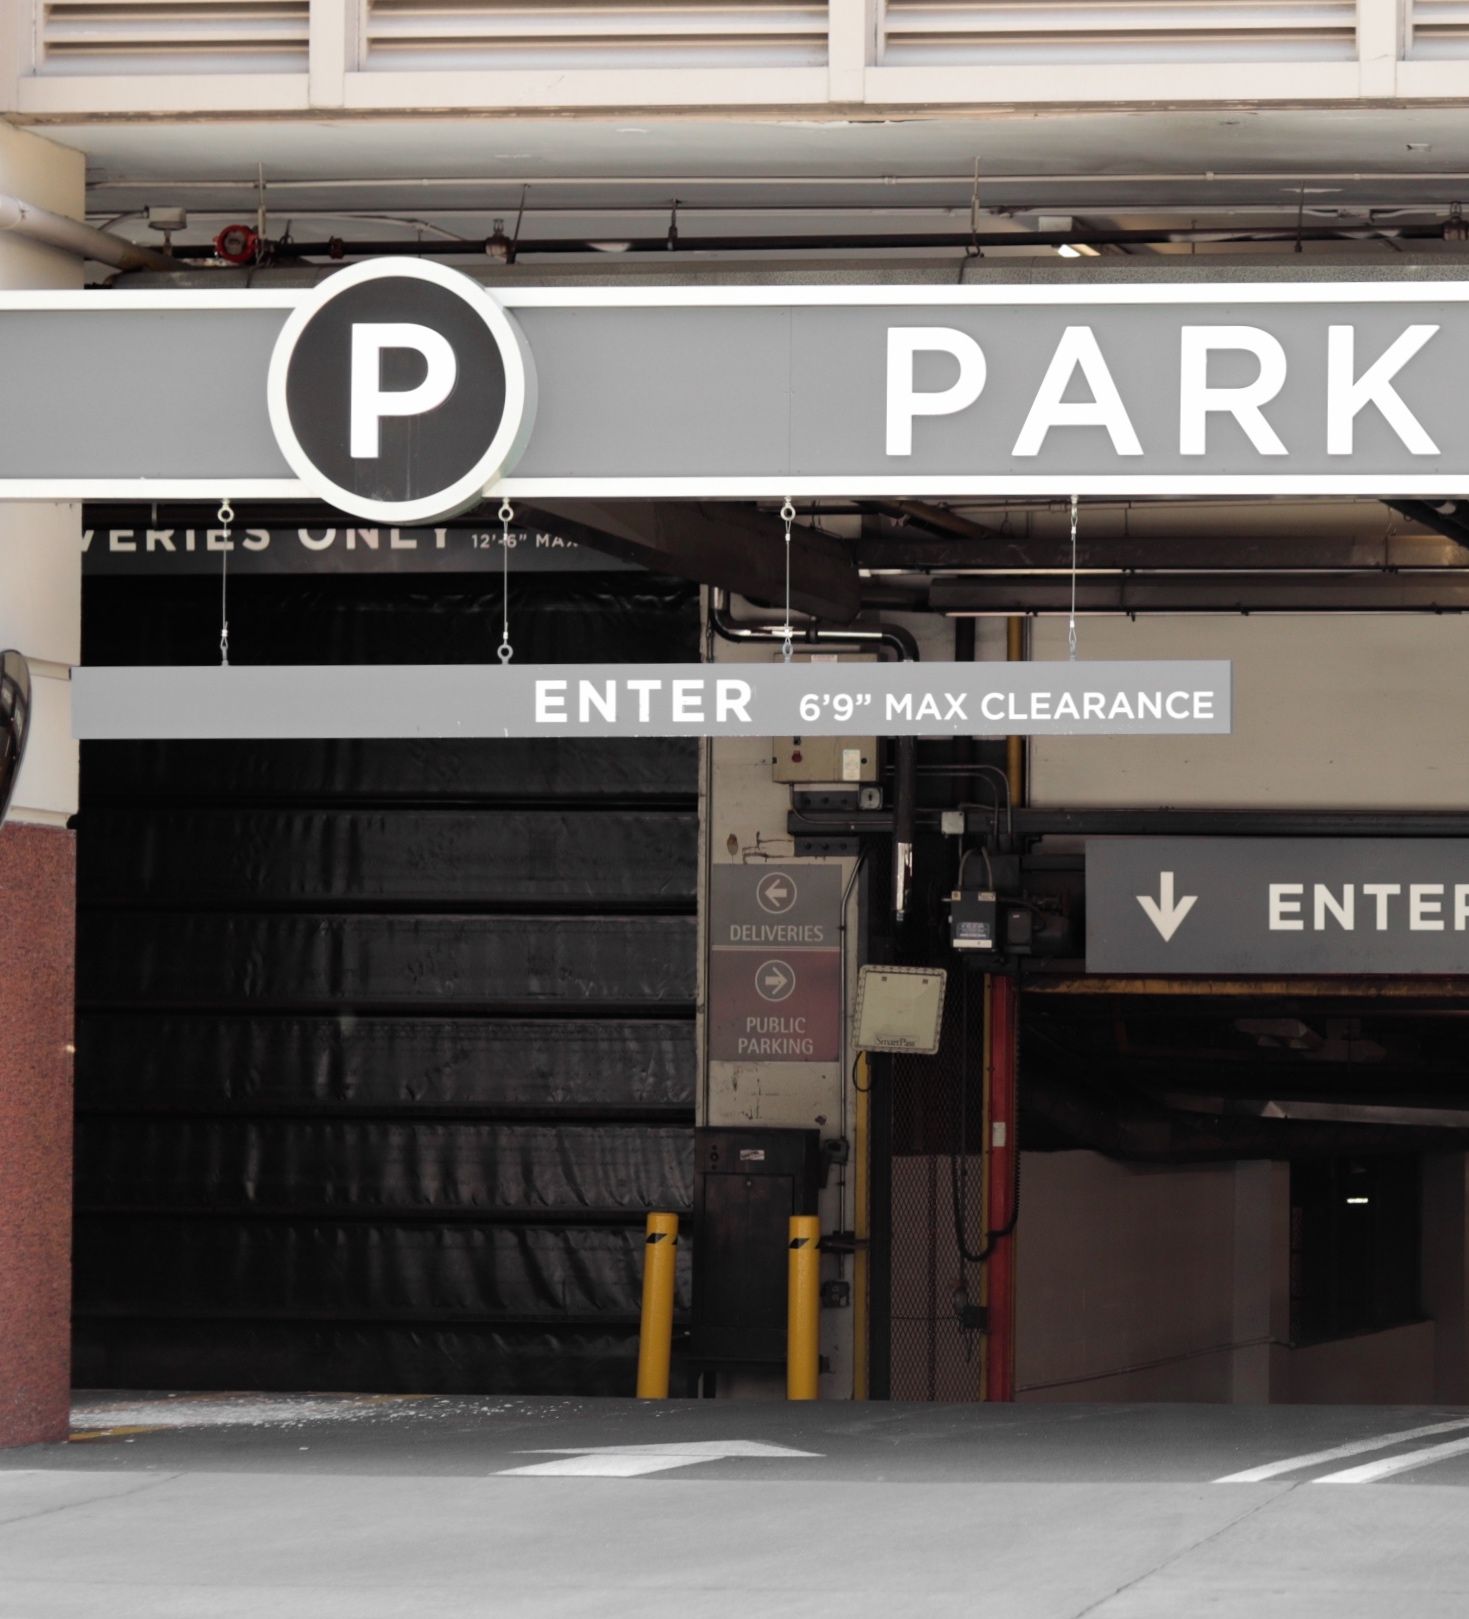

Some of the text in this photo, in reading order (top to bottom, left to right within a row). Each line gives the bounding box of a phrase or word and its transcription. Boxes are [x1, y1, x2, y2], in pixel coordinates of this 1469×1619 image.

[350, 323, 458, 459] P
[534, 679, 753, 723] ENTER
[885, 692, 968, 721] MAX
[980, 690, 1214, 721] CLEARANCE
[730, 924, 824, 942] DELIVERIES
[746, 1017, 806, 1034] PUBLIC
[738, 1038, 814, 1055] PARKING
